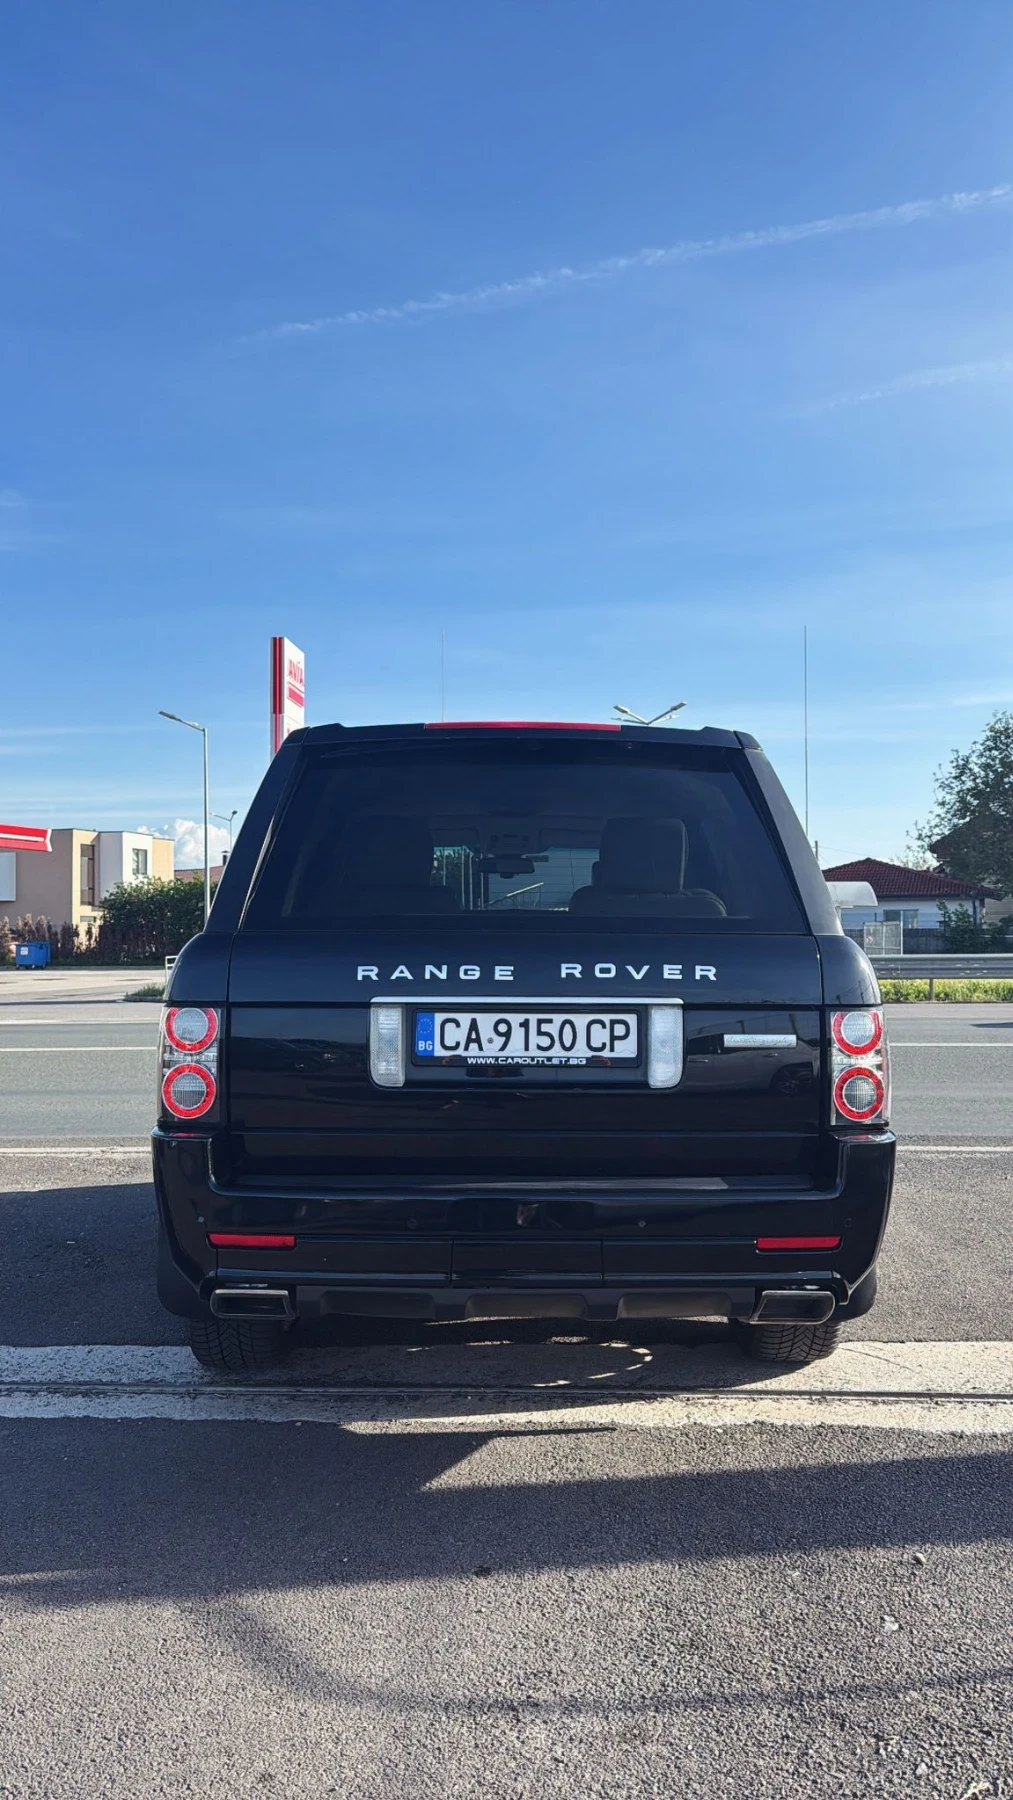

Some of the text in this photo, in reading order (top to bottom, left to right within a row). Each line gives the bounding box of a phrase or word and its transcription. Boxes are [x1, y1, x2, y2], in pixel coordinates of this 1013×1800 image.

[357, 963, 717, 981] RANGE ROVER
[439, 1018, 631, 1053] CA 9150 CP
[418, 1041, 433, 1051] BG
[467, 1057, 587, 1065] WWW.CAROUTLET.BG
